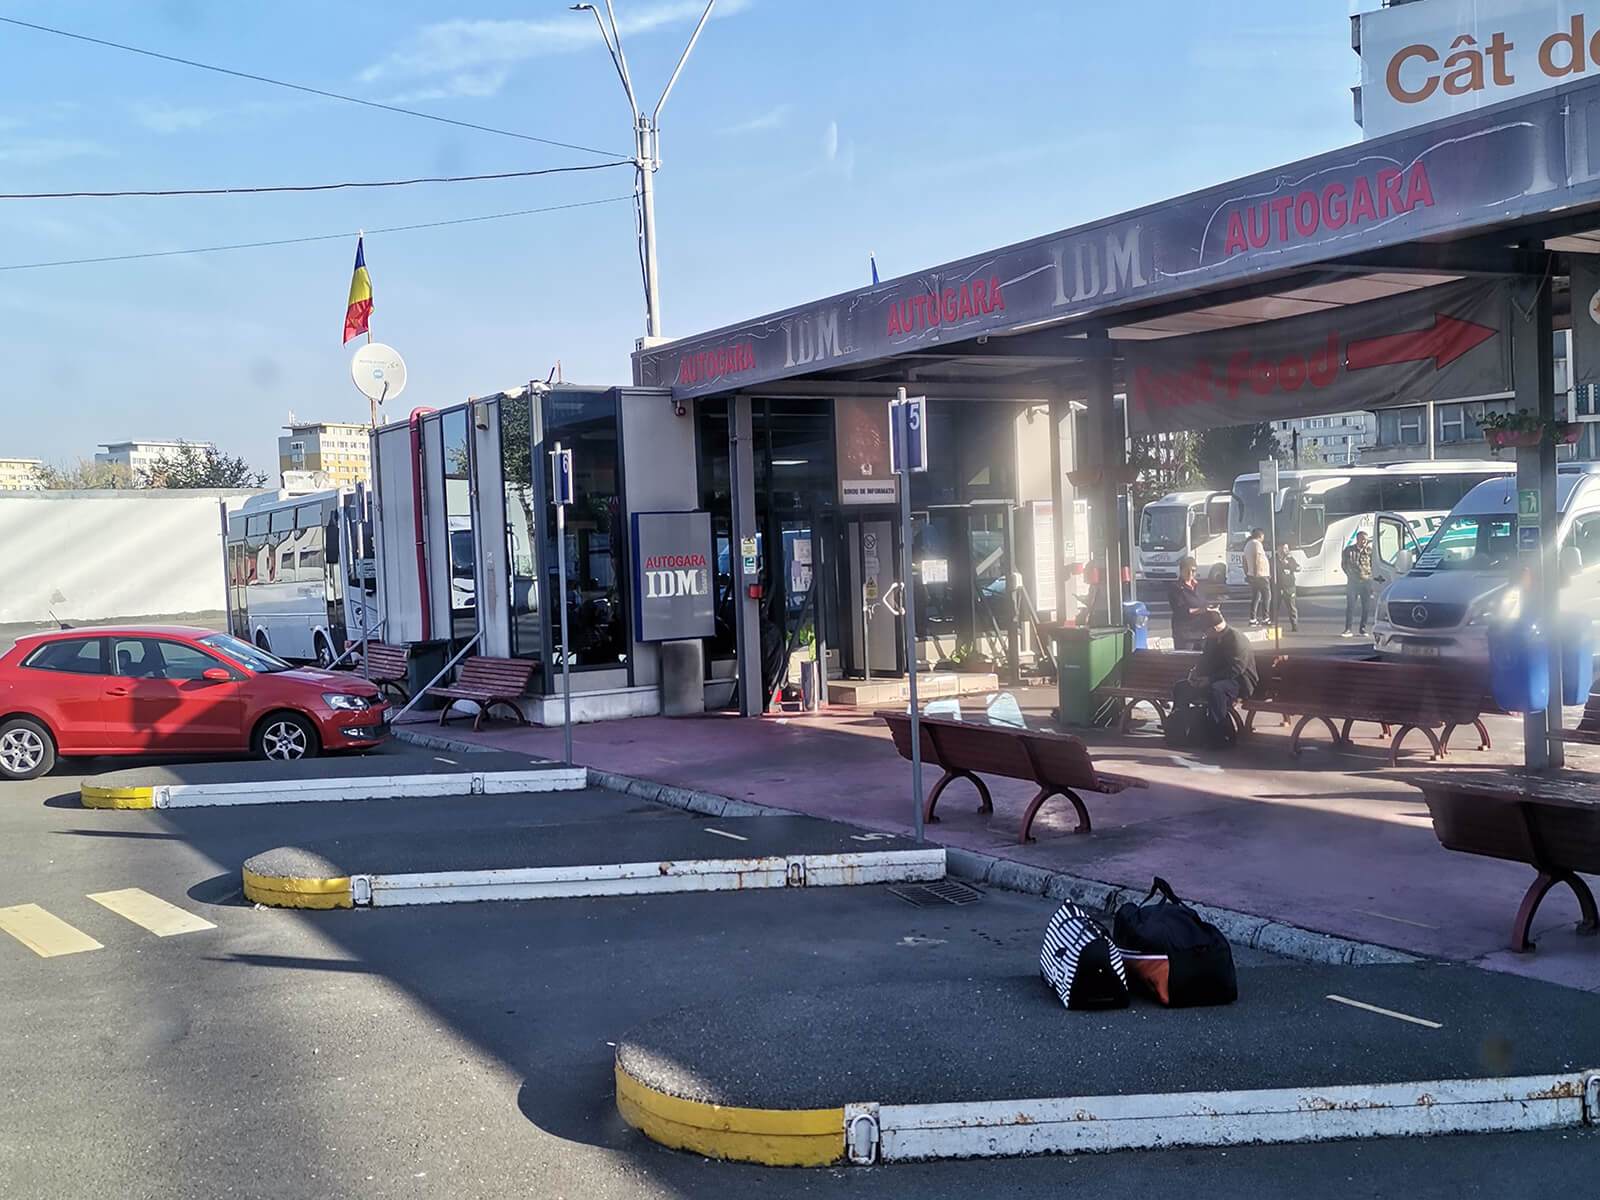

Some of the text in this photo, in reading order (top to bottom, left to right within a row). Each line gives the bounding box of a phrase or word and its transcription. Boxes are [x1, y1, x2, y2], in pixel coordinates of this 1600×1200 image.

[1386, 13, 1600, 104] Cât d
[1224, 160, 1434, 256] AUTOGARA
[1050, 224, 1147, 306] IDM
[887, 276, 1006, 337] AUTOGARA
[679, 343, 756, 384] AUTOGARA
[783, 310, 843, 369] IDM
[910, 403, 920, 430] 5
[645, 555, 706, 569] AUTOGARA
[645, 569, 700, 598] IDM
